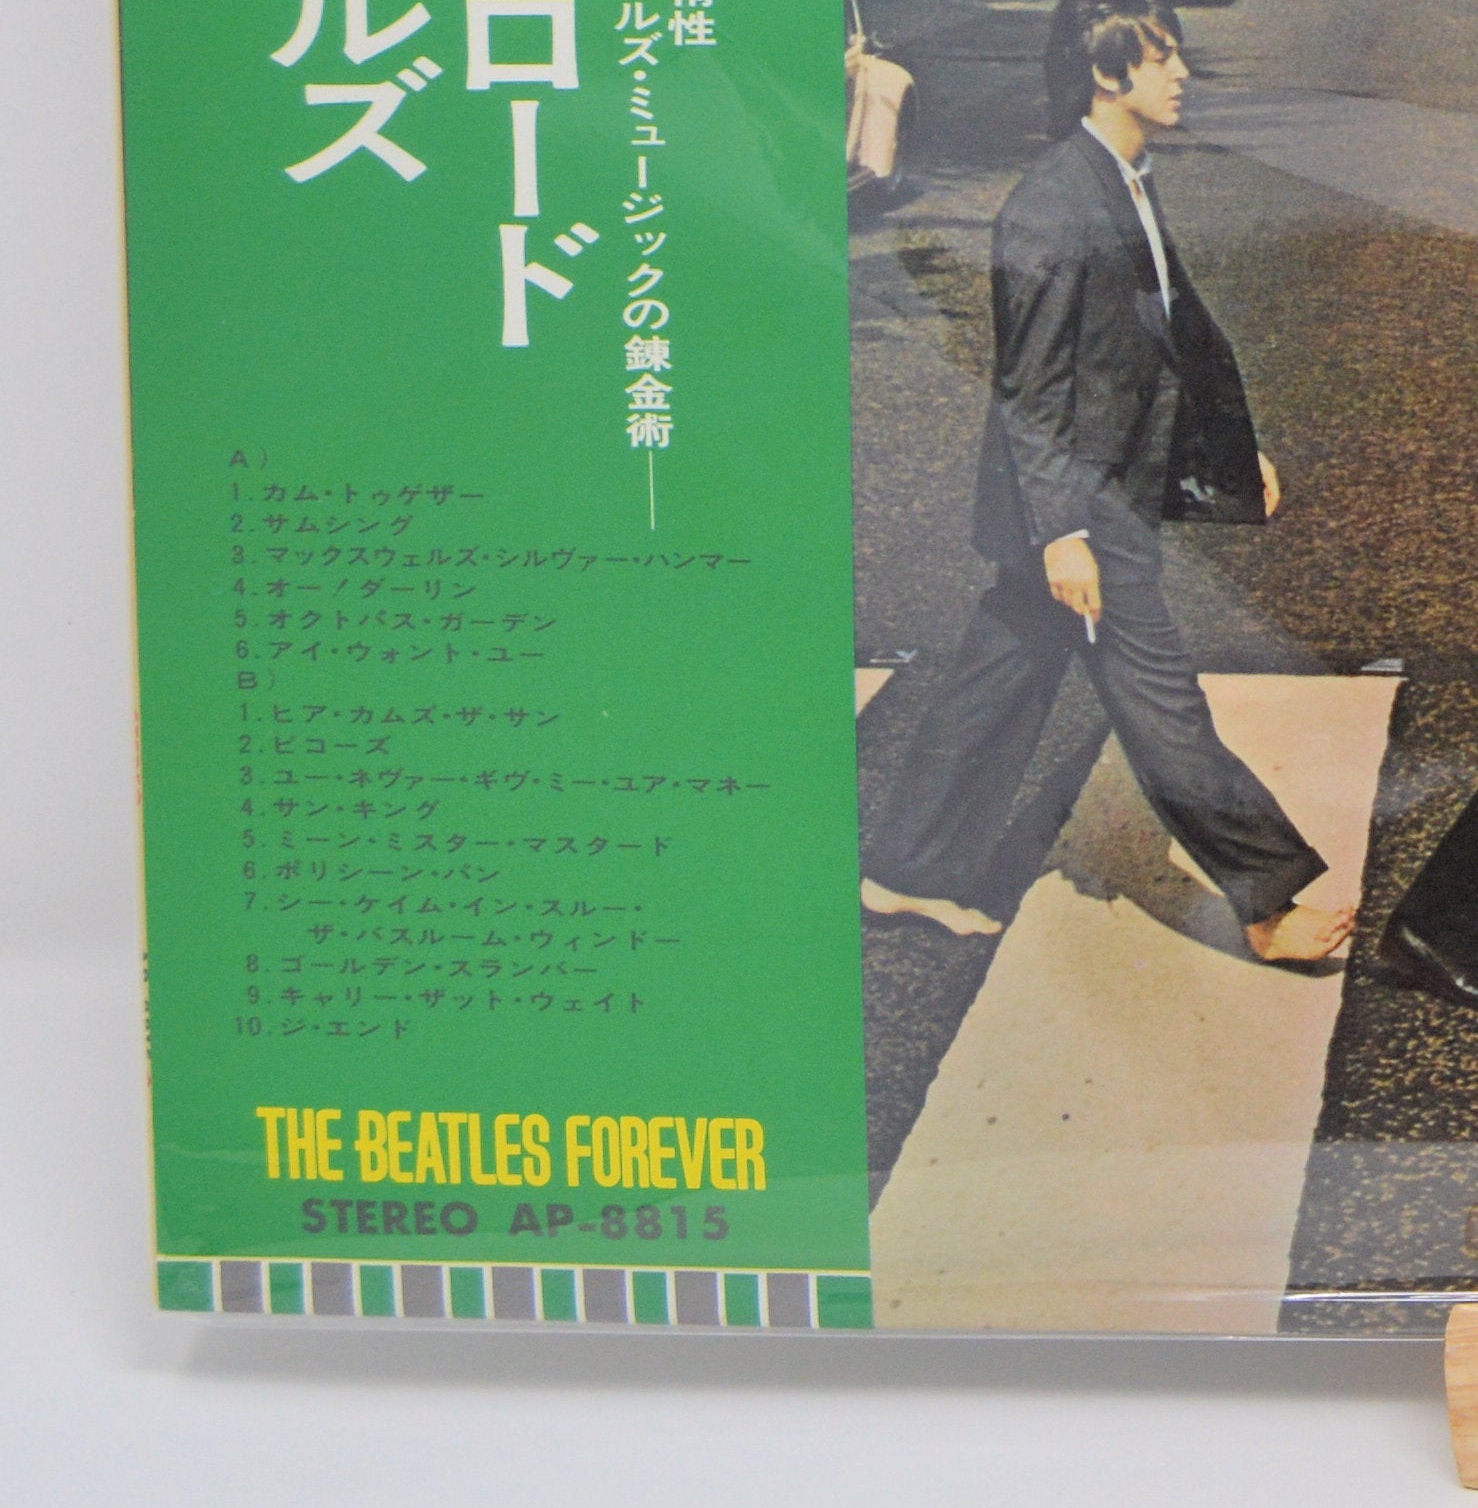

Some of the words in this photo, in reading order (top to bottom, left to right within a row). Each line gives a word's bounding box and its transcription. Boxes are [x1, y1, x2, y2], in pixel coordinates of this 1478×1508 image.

[256, 1105, 344, 1183] THE
[354, 1108, 551, 1188] BEATLES
[565, 1114, 766, 1192] FOREVER
[302, 1198, 478, 1237] STEREO
[509, 1202, 730, 1241] AP-8815
